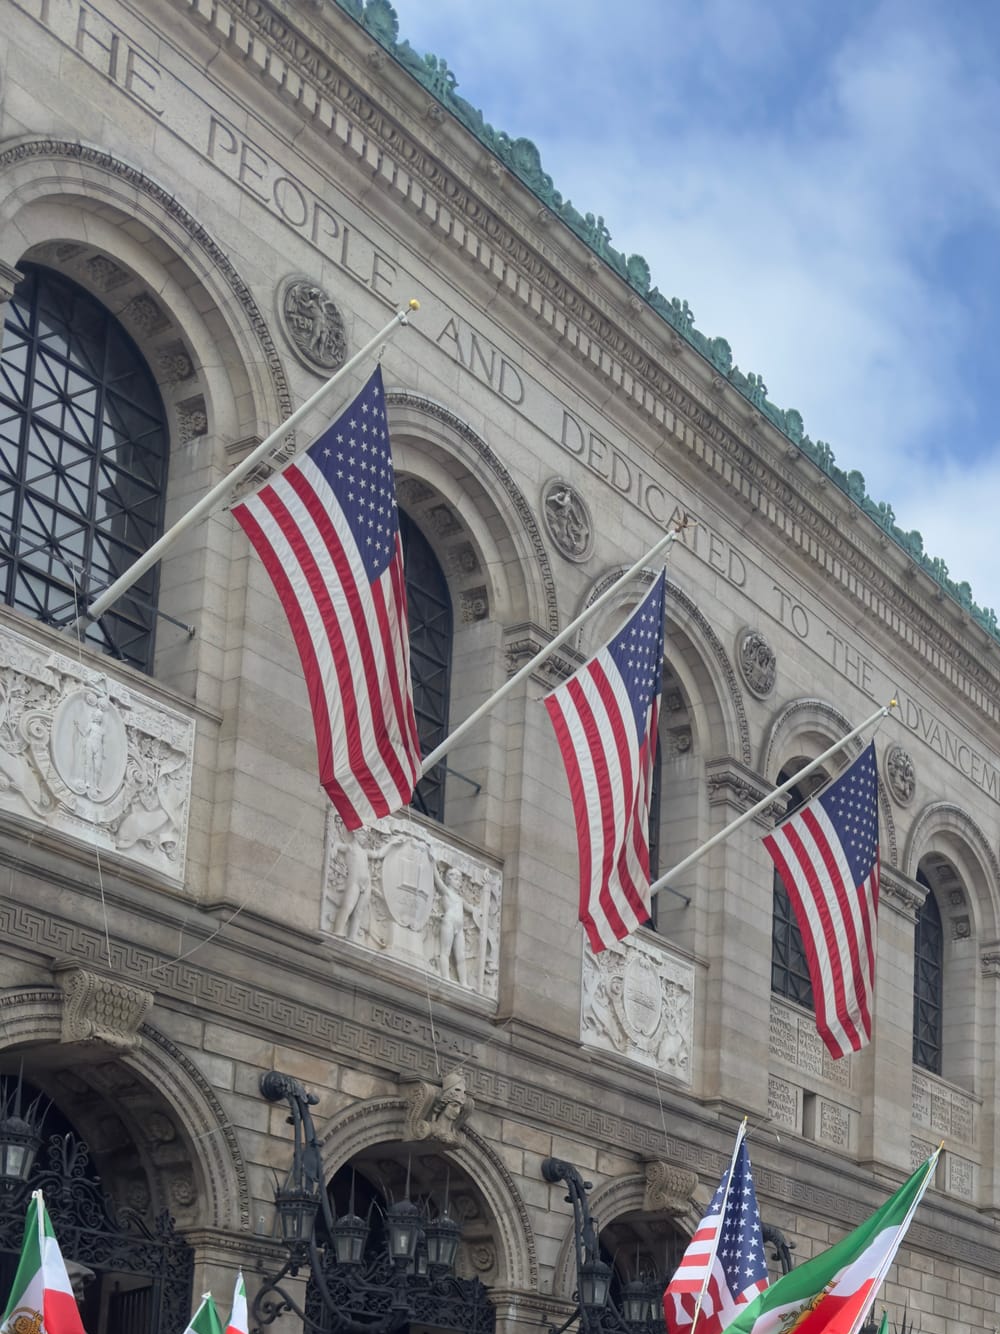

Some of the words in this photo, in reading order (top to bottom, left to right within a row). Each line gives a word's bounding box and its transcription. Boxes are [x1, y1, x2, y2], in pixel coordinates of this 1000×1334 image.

[207, 114, 400, 308] PEOPLE
[436, 317, 525, 405] AND
[561, 410, 746, 587] DEDICATED
[773, 585, 809, 639] TO
[827, 630, 875, 698] THE
[371, 1005, 412, 1034] FREE
